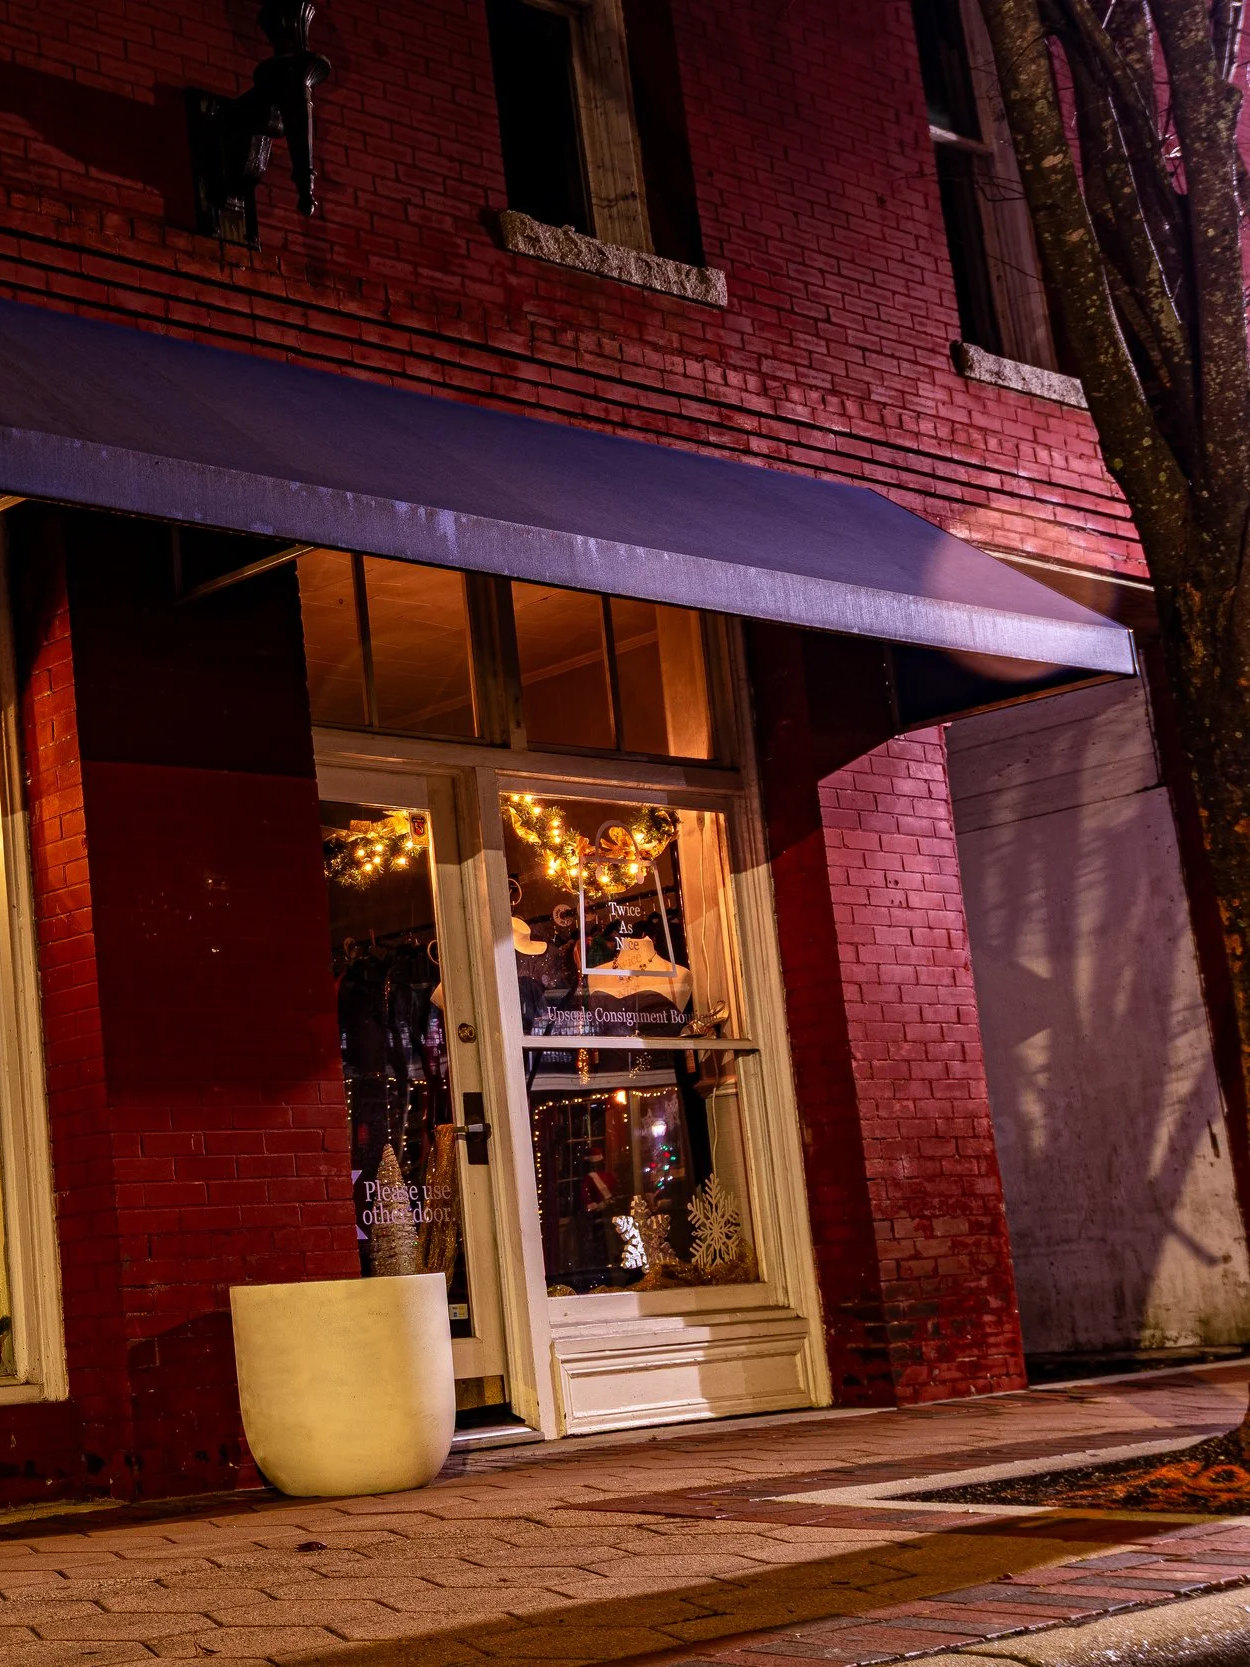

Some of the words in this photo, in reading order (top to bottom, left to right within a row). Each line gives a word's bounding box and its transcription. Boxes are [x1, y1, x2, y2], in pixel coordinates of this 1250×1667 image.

[608, 901, 641, 917] Twice
[619, 920, 633, 934] As
[547, 1006, 593, 1024] Upscale
[595, 1007, 668, 1026] Consignment
[364, 1180, 419, 1202] Please
[422, 1184, 452, 1200] use
[362, 1202, 409, 1225] other
